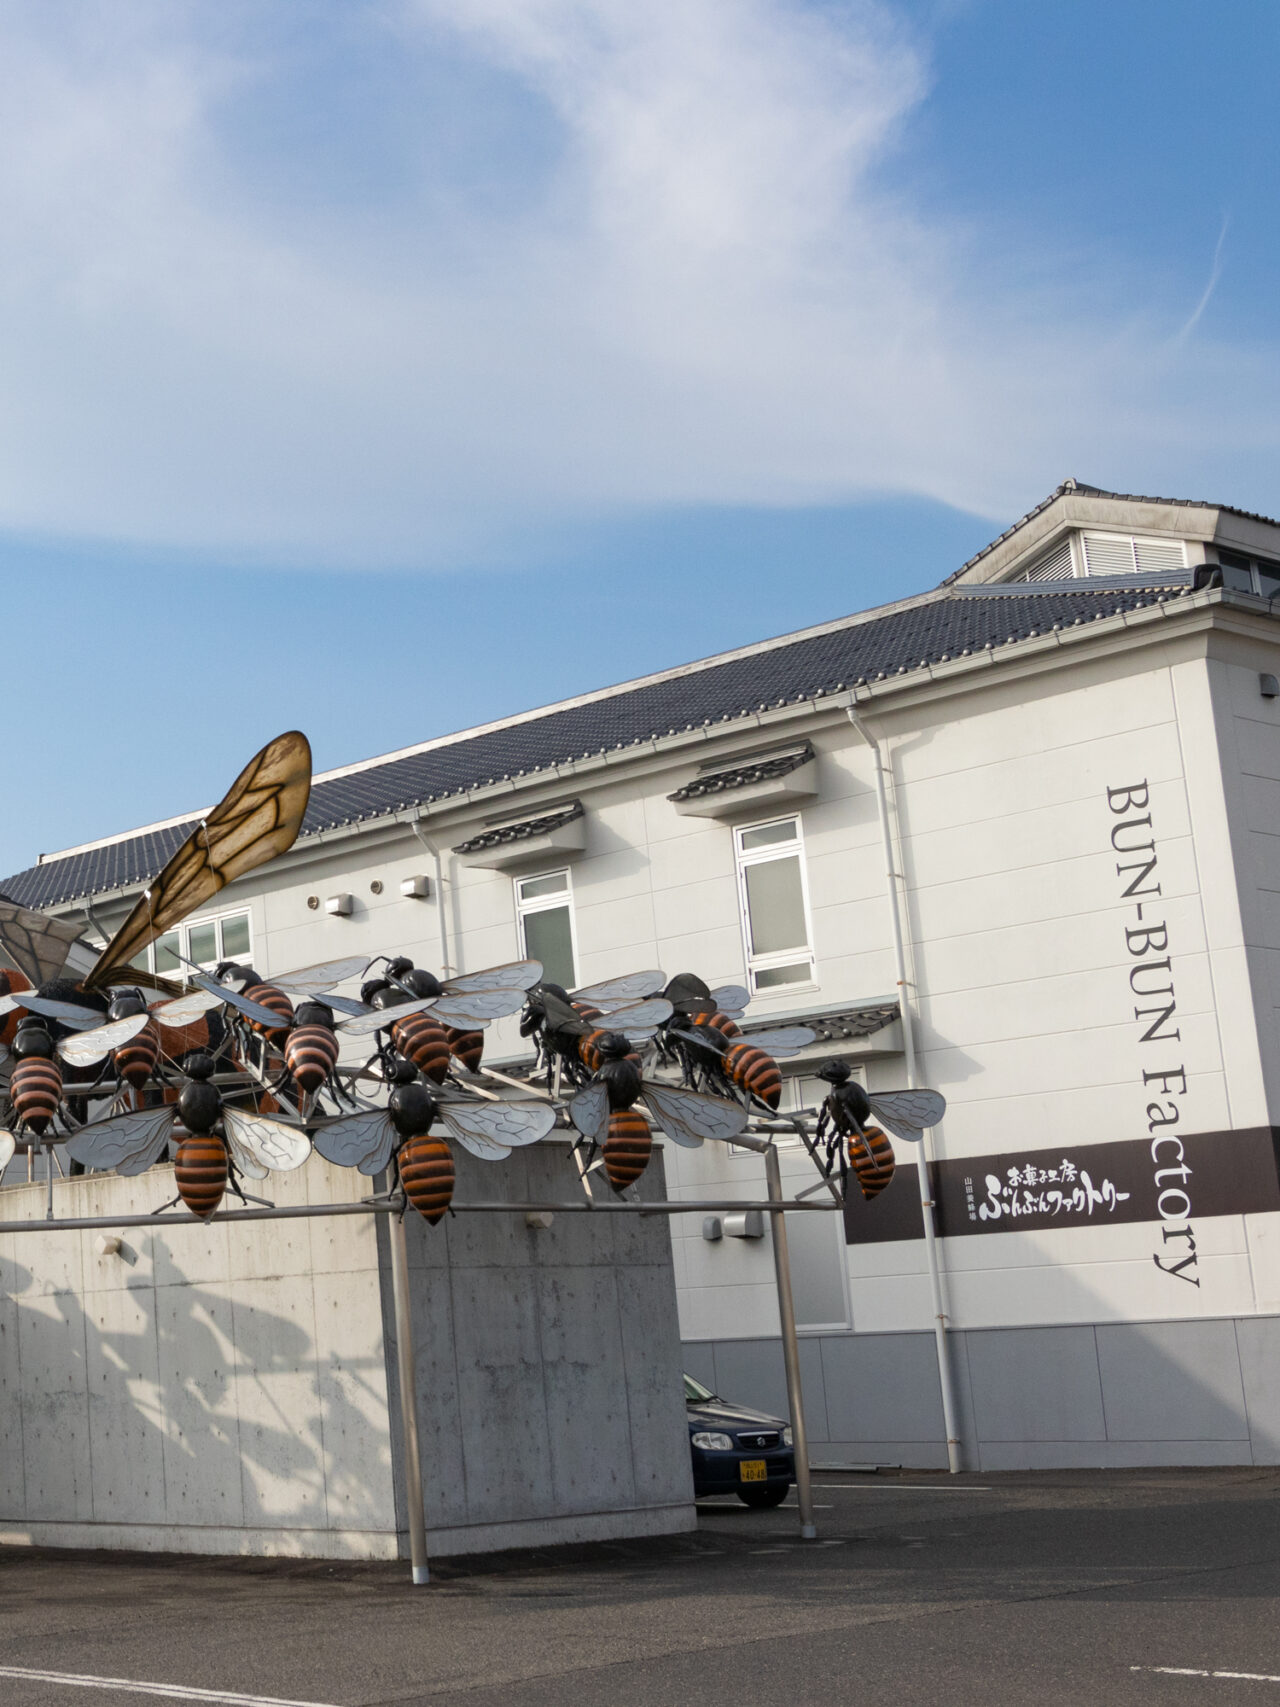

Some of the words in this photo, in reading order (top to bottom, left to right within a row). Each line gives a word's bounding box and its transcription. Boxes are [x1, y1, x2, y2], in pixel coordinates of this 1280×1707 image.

[1106, 777, 1181, 1043] BUN-BUN
[978, 1170, 1131, 1221] ぶんぶんファクトリー
[1006, 1158, 1078, 1187] お菓子工房
[1142, 1063, 1201, 1289] Factory
